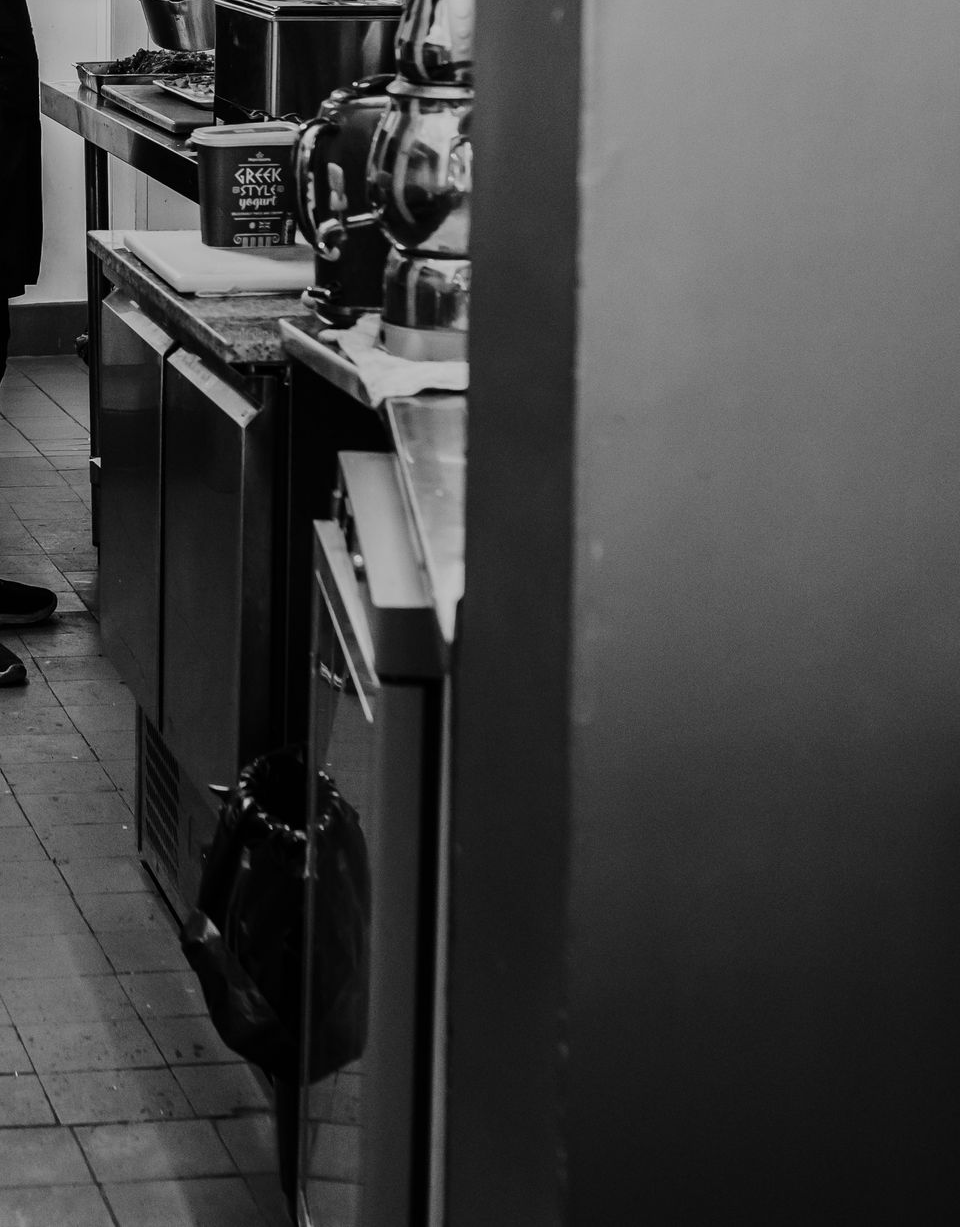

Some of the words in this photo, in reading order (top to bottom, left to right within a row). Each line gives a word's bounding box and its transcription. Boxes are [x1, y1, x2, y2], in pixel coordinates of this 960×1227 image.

[234, 167, 282, 184] GREEK
[240, 184, 276, 196] STYLE
[239, 195, 277, 211] yogurt
